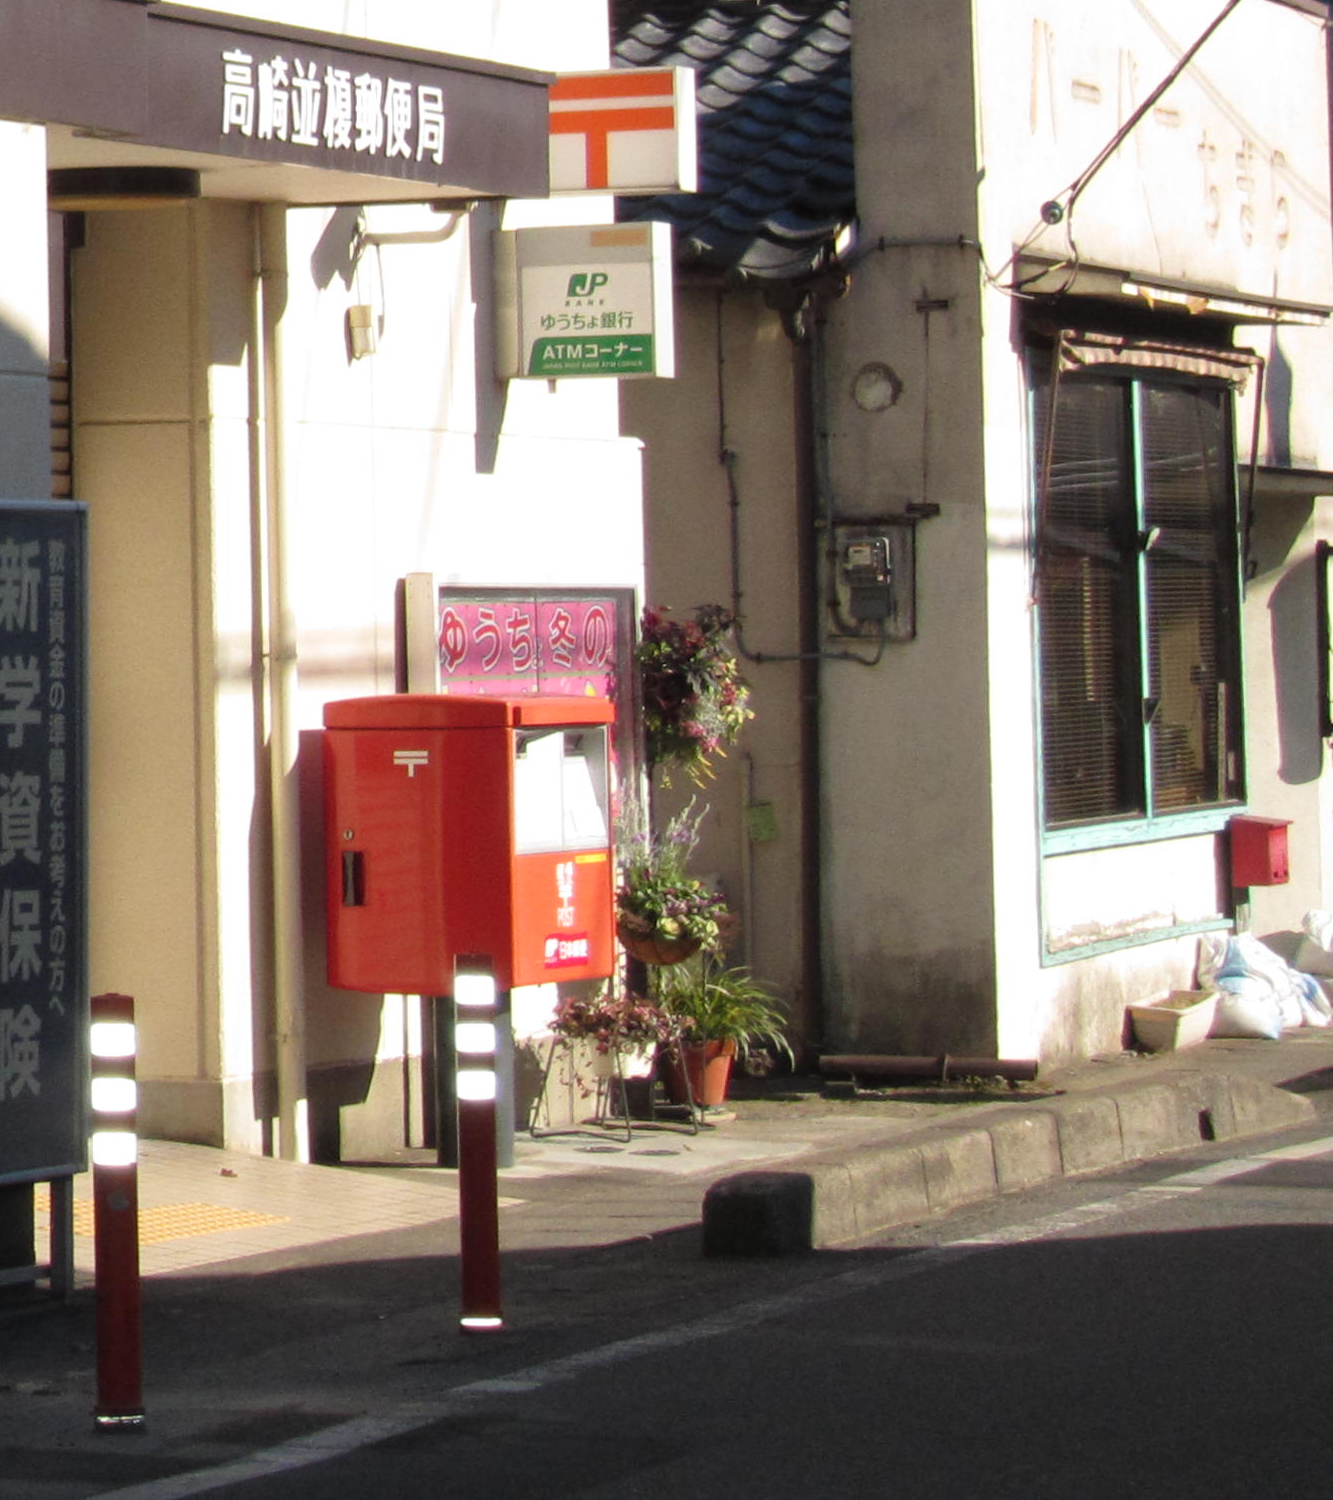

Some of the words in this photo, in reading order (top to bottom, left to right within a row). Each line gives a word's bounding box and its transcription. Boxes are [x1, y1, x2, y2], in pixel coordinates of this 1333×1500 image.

[220, 48, 447, 166] 高崎並榎郵便局
[540, 310, 634, 331] ゆうちょ銀行
[542, 342, 644, 360] ATMコーナー
